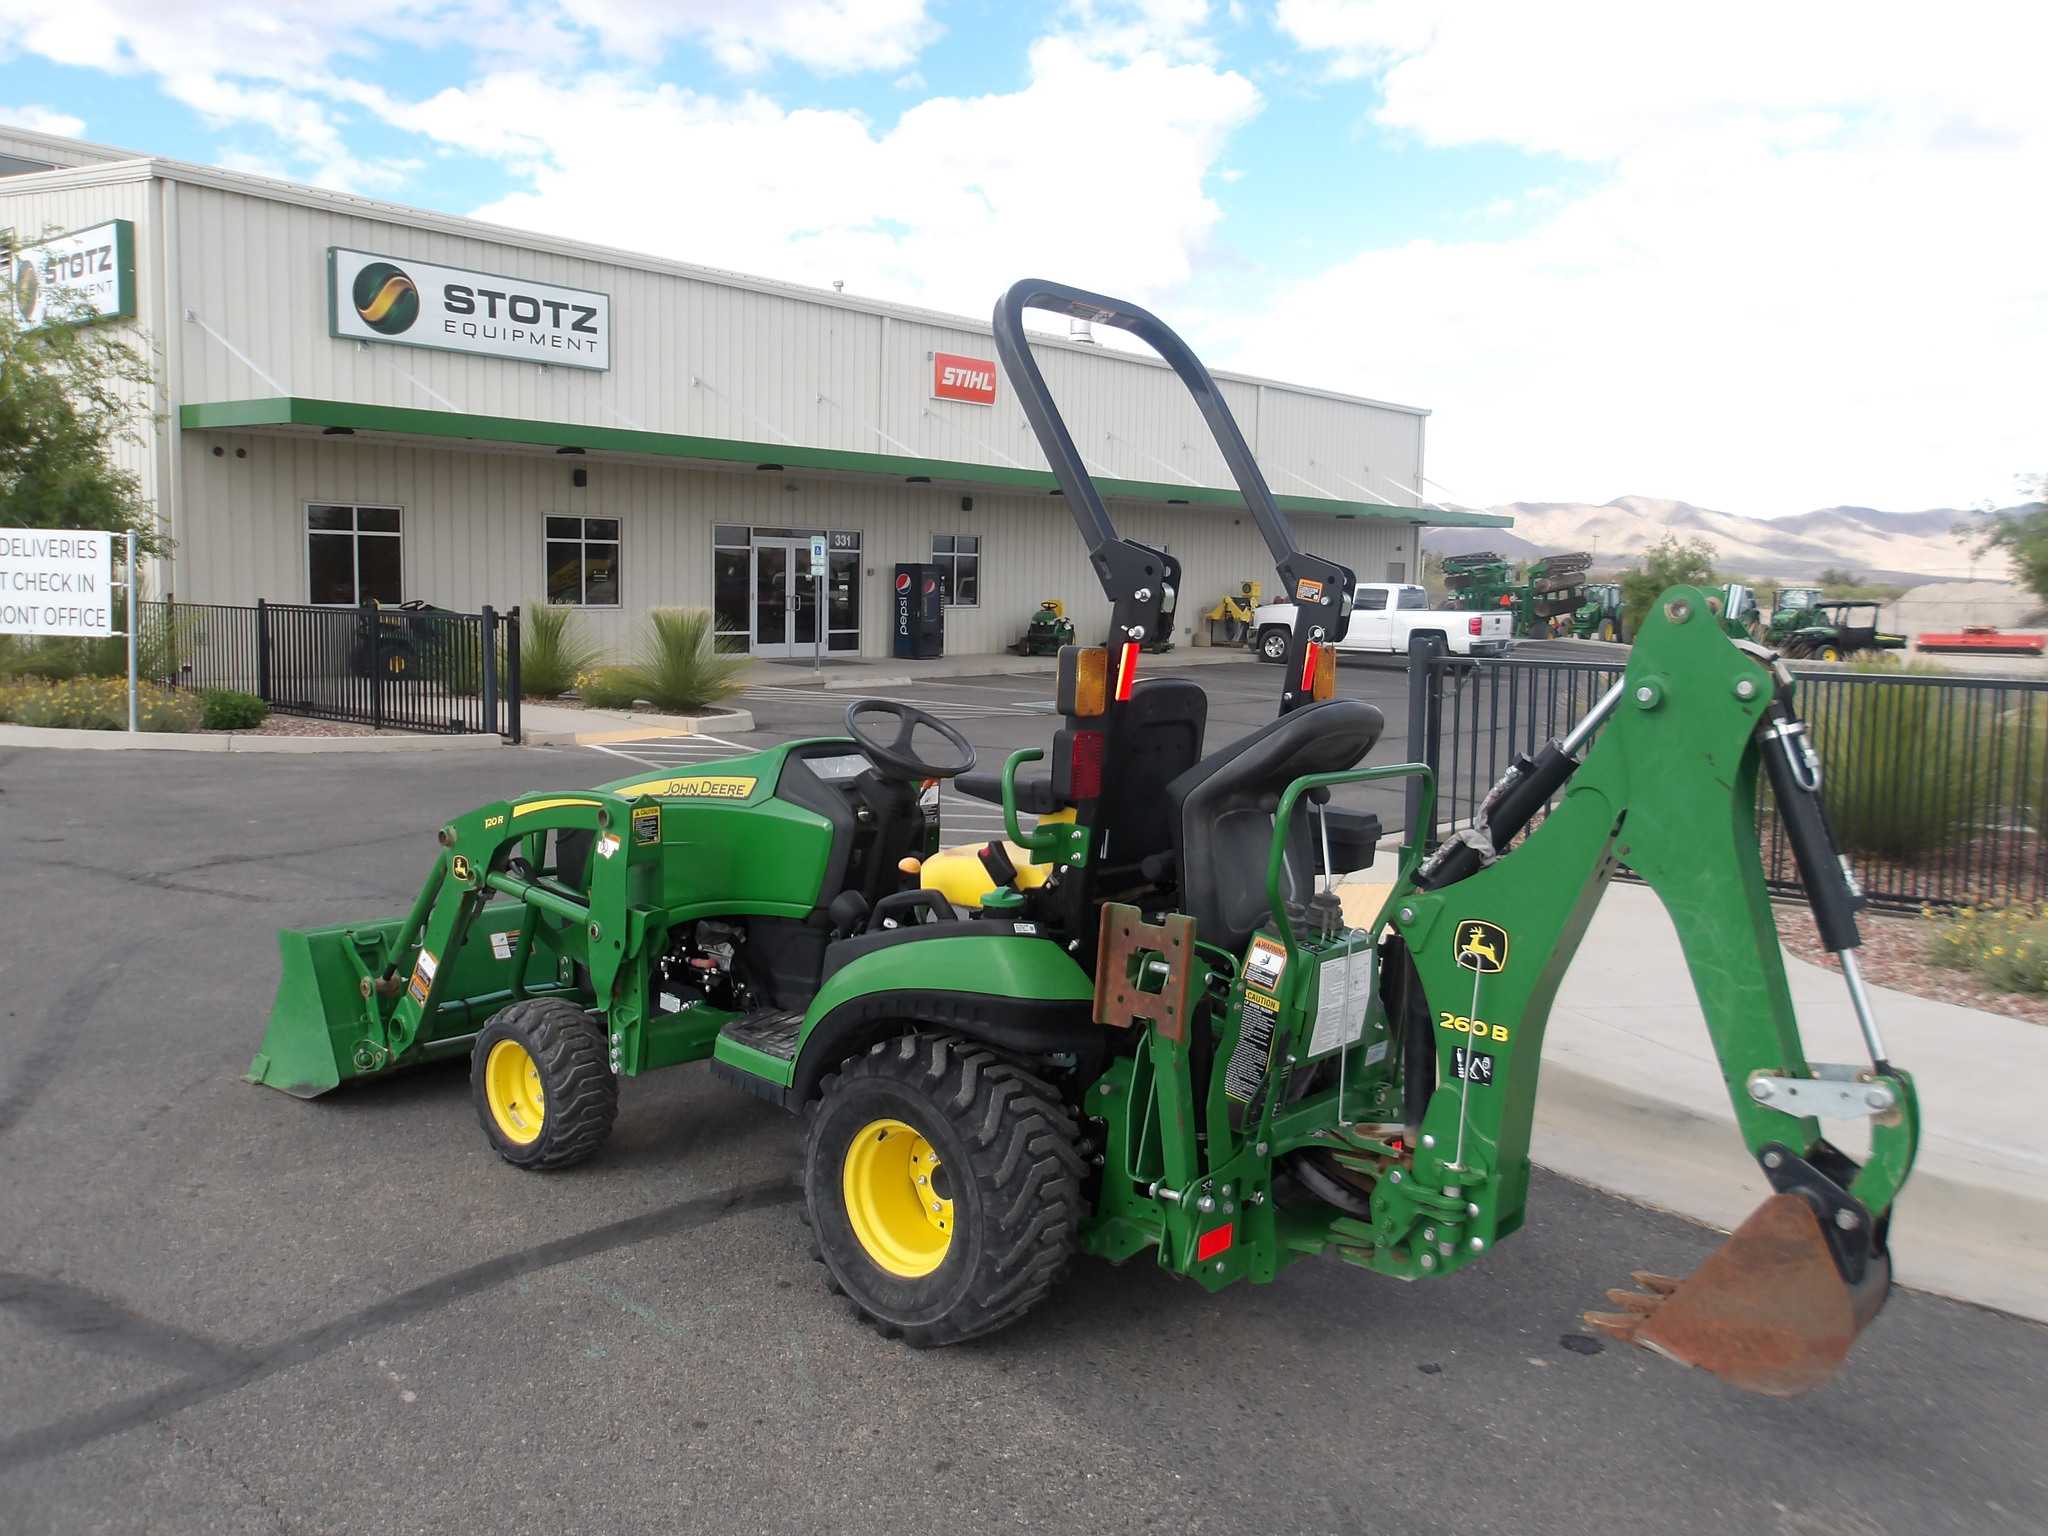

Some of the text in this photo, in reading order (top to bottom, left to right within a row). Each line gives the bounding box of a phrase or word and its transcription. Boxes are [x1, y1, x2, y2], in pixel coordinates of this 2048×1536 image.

[45, 245, 112, 284] STOTZ
[444, 284, 598, 334] STOTZ
[444, 320, 598, 353] EQUIPMENT
[941, 366, 993, 391] STIHL
[834, 535, 851, 547] 331
[13, 572, 72, 592] CHECK
[78, 574, 94, 593] IN
[0, 605, 106, 627] ONT OFFICE
[899, 597, 909, 635] pepsi
[663, 781, 746, 796] JOHN DEERE
[1260, 940, 1286, 957] WARNING
[1247, 991, 1276, 1009] CAUTION
